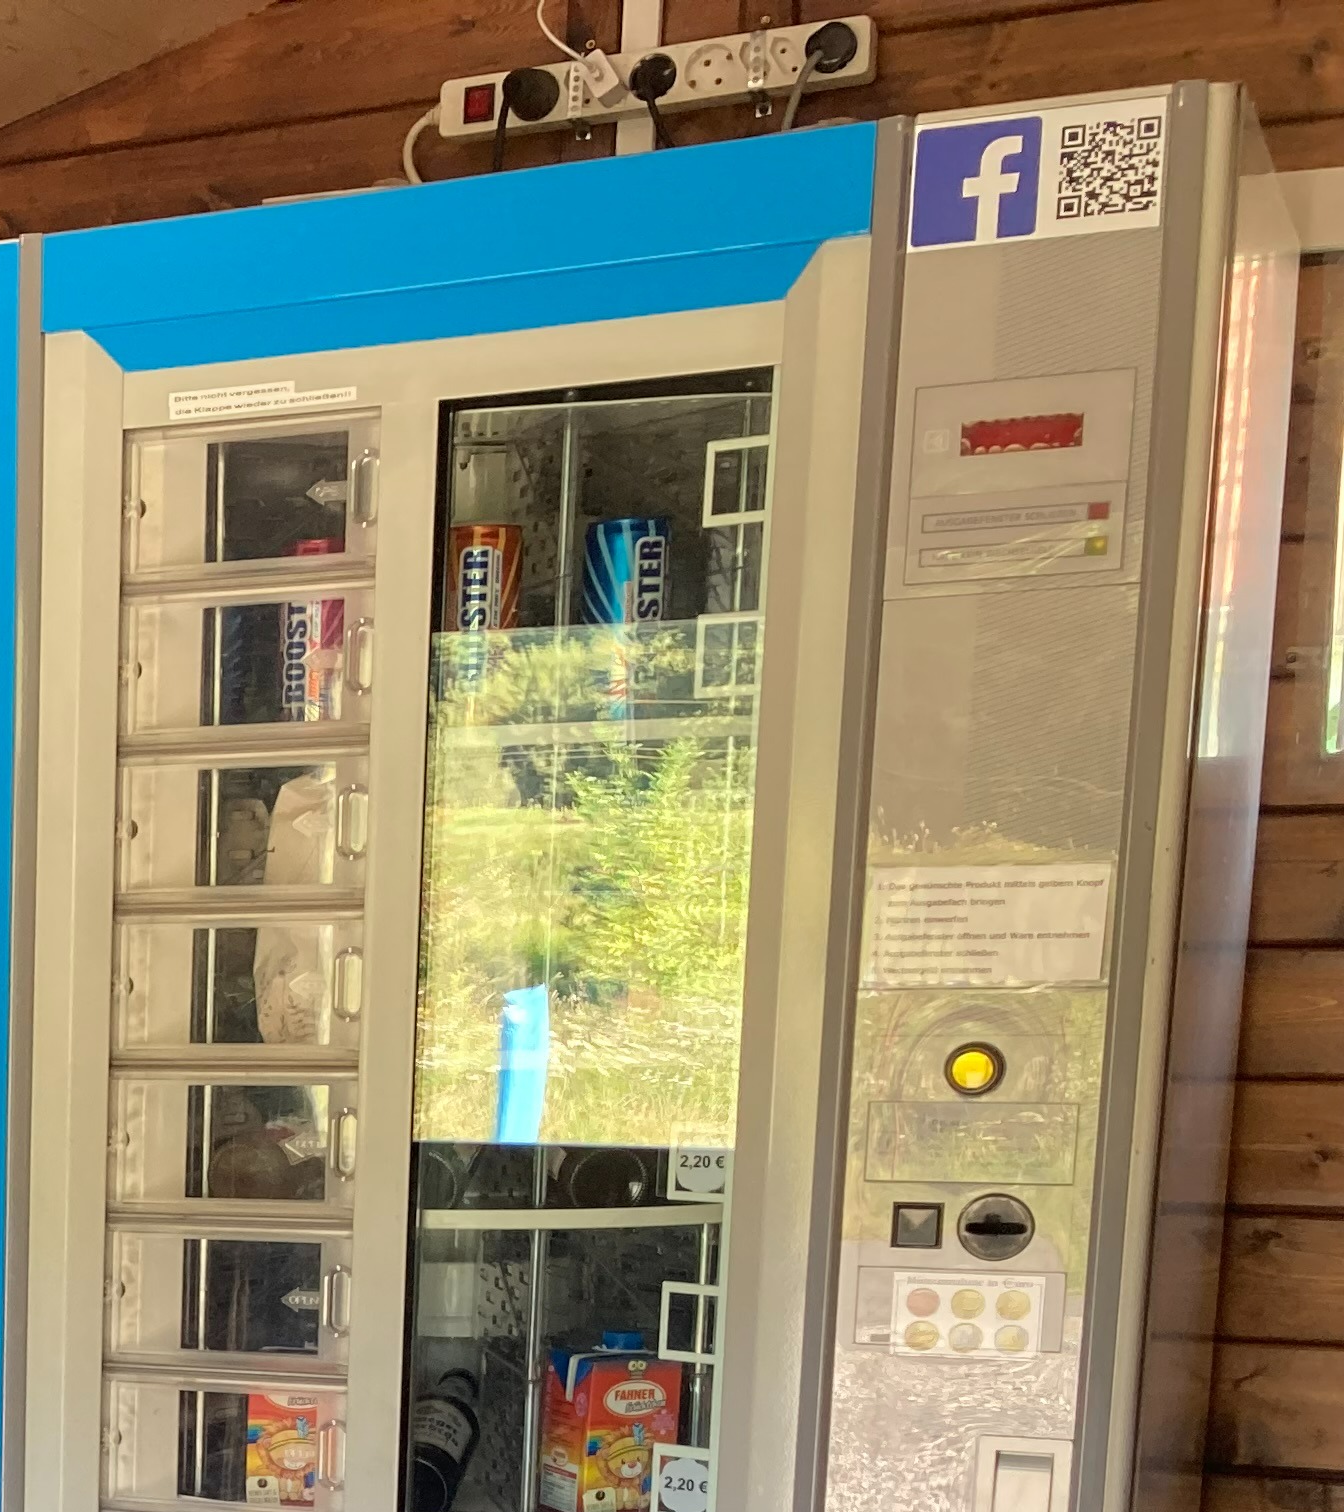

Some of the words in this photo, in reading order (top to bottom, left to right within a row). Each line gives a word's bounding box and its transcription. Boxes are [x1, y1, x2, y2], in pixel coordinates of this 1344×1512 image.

[962, 135, 1023, 241] f
[965, 880, 1002, 888] Produkt
[1076, 878, 1105, 888] Knopf
[1037, 931, 1090, 939] entnehmen
[680, 1154, 711, 1170] 2,20
[715, 1154, 725, 1169] €
[664, 1477, 694, 1491] 2,20
